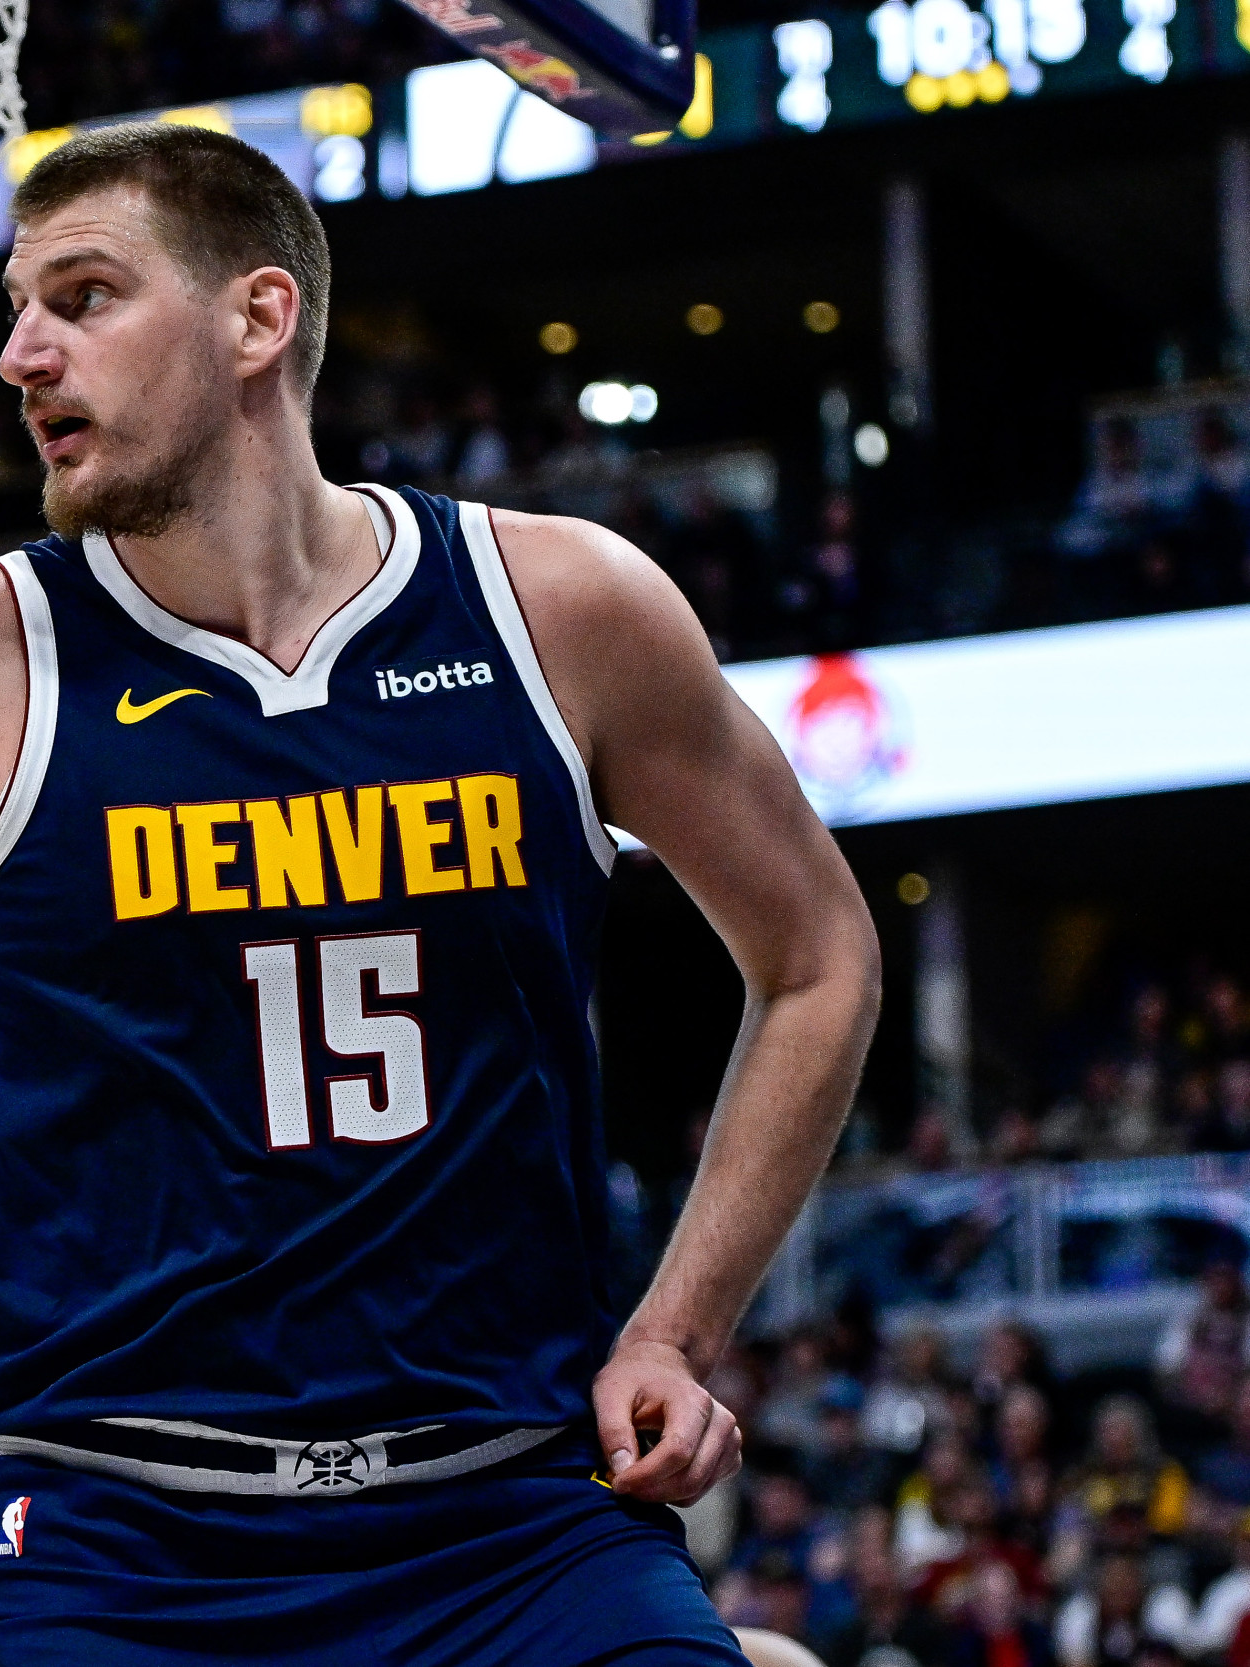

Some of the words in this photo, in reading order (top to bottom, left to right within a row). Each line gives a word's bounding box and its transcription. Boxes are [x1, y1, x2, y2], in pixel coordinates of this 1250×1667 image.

[376, 659, 495, 701] ibotta
[103, 771, 530, 922] DENVER
[239, 928, 432, 1152] 15
[0, 1543, 13, 1555] NBA
